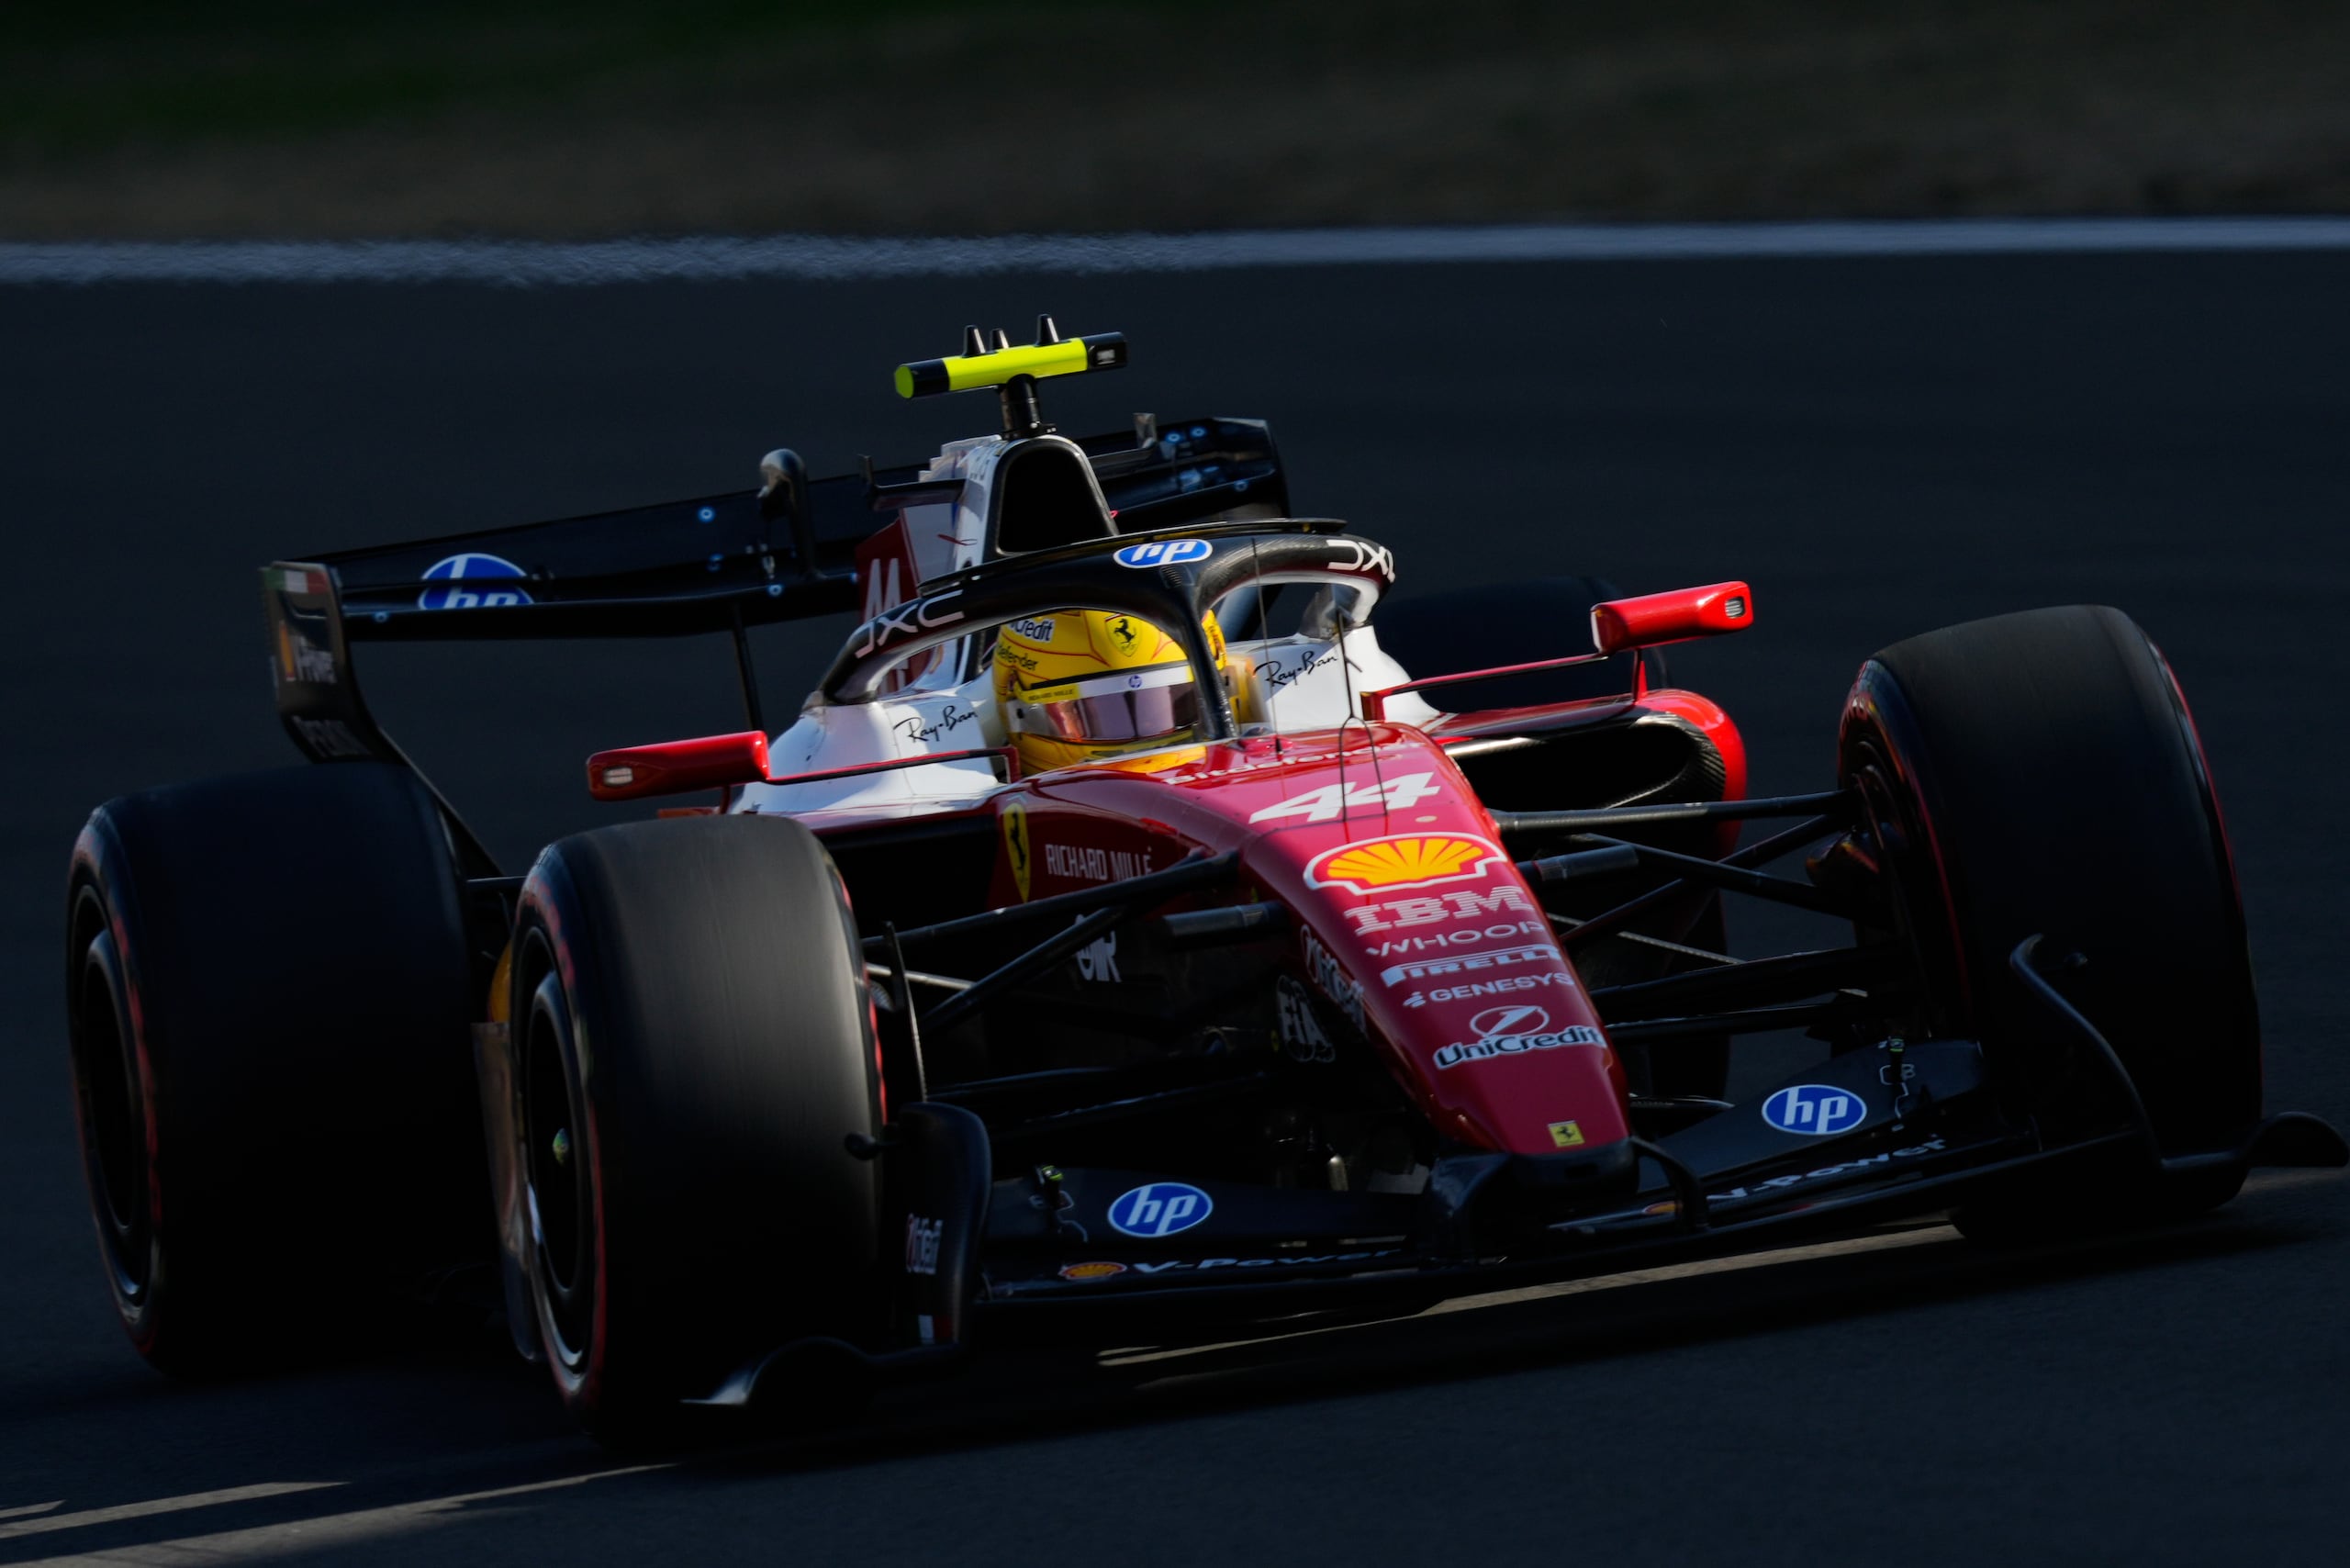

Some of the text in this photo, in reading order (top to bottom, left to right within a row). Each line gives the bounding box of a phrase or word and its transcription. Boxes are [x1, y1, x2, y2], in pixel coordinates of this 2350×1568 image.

[1130, 540, 1197, 567] hp
[1011, 620, 1054, 642] Credit
[1253, 650, 1339, 688] Ray-Ban
[892, 705, 979, 743] Ray-Ban
[1248, 772, 1441, 824] 44
[1044, 843, 1110, 882] RICHARD
[1344, 886, 1536, 937] IBM
[1365, 921, 1547, 958] WHOOP
[1380, 944, 1562, 989] PIRELLI
[1429, 972, 1576, 1002] GENESYS
[1432, 1025, 1607, 1070] UniCredit
[1783, 1087, 1851, 1135] hp
[1125, 1183, 1200, 1236] hp
[1131, 1247, 1404, 1274] V-Power
